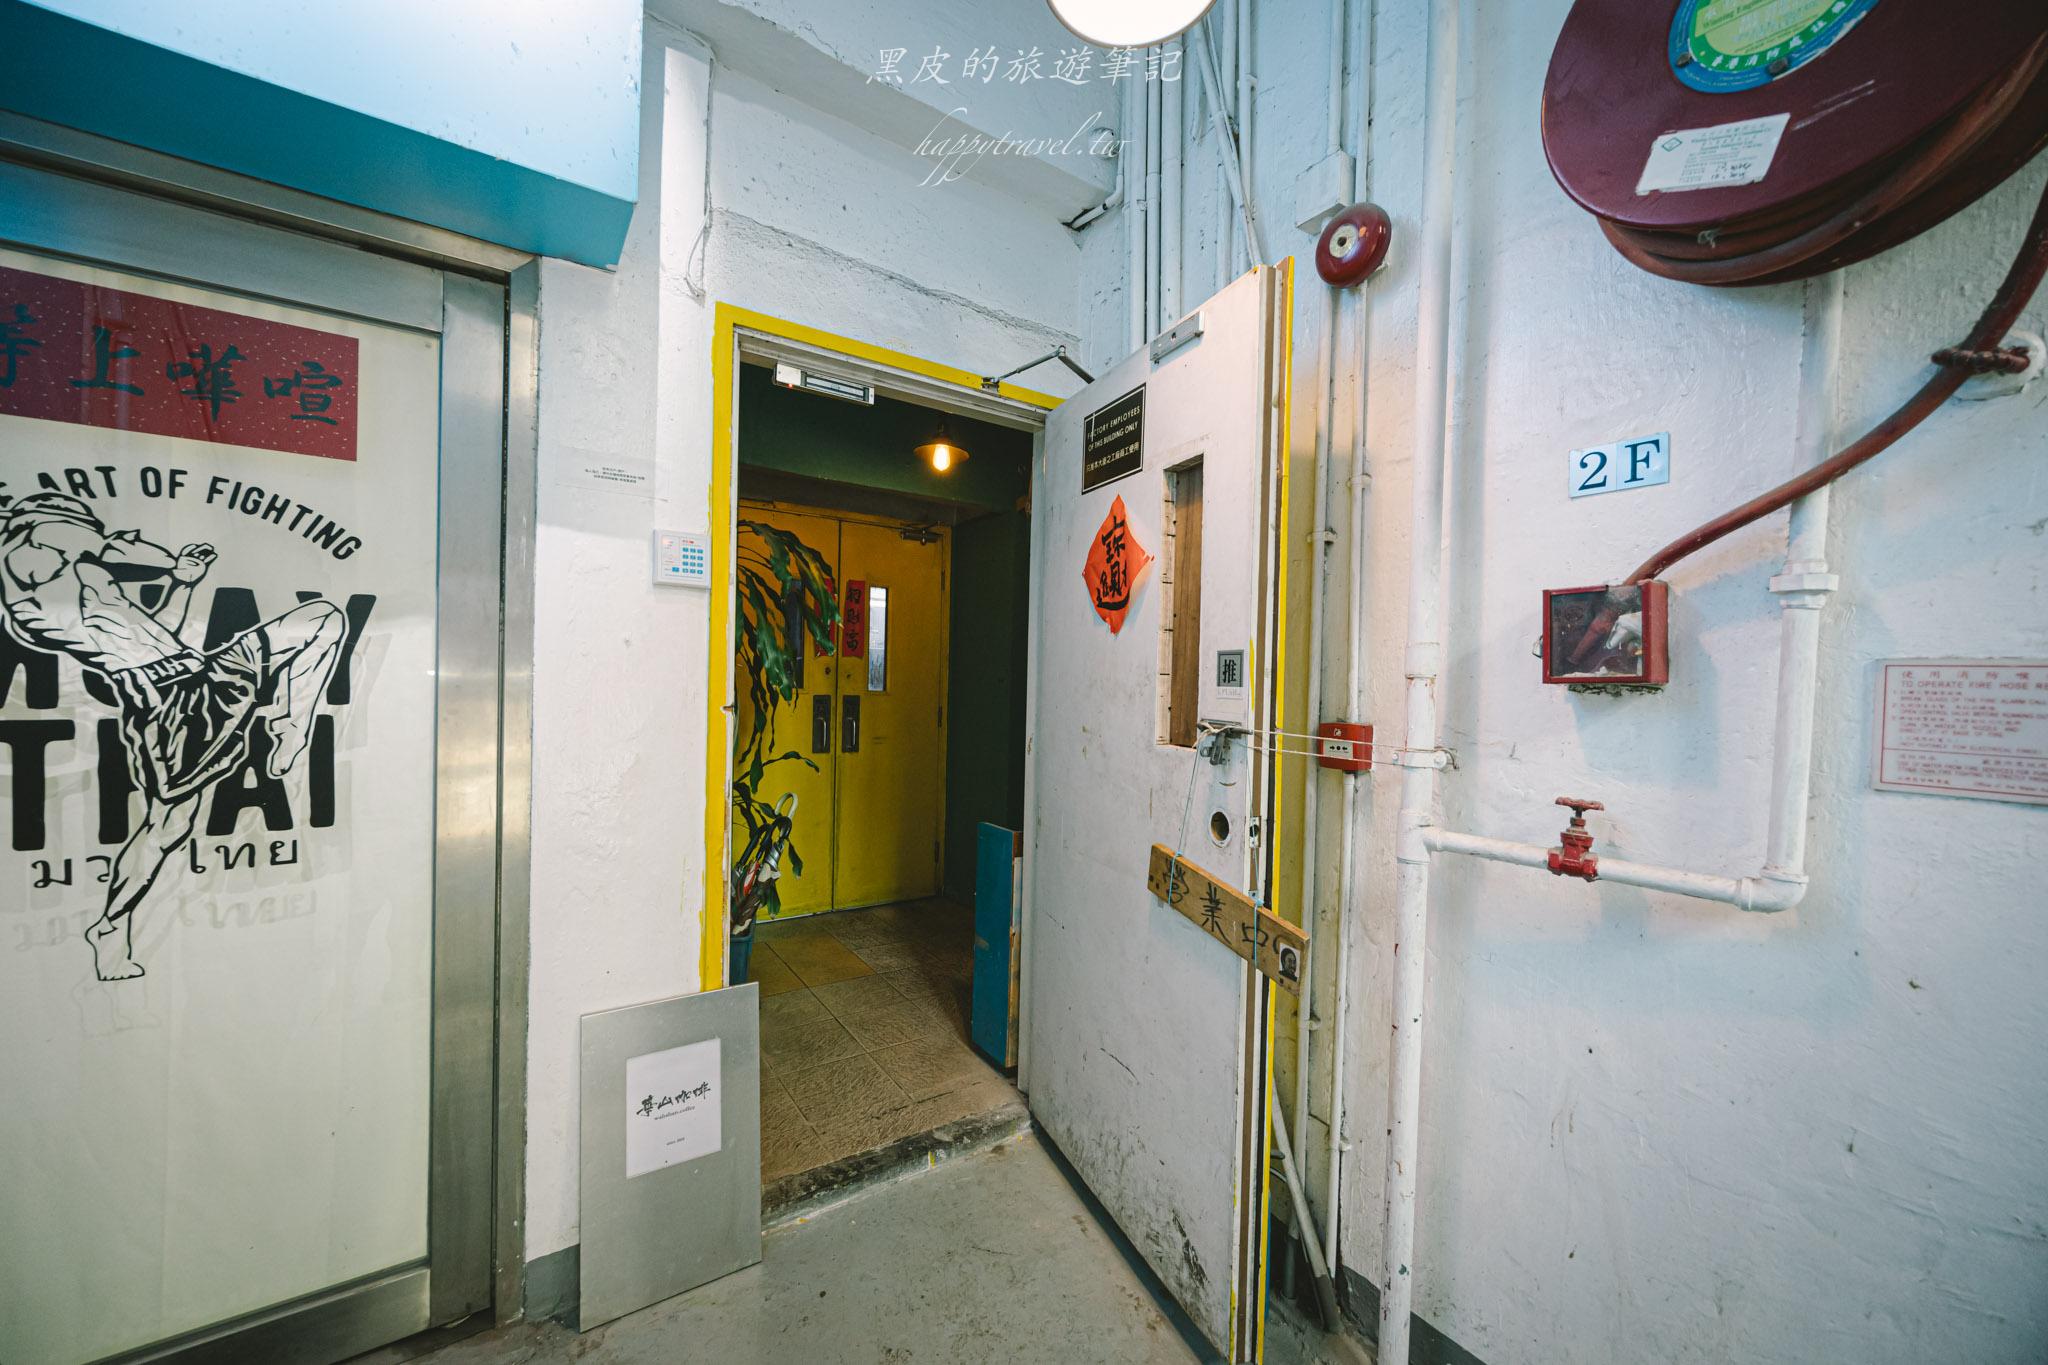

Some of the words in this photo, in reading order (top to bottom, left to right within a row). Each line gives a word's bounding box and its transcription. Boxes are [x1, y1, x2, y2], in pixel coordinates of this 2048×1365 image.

[1110, 406, 1140, 427] EMPLOYEES
[1088, 443, 1094, 452] OF
[1095, 439, 1103, 448] THIS
[1103, 429, 1124, 445] BUILDING
[1125, 421, 1138, 434] ONLY
[140, 466, 188, 499] OF
[206, 476, 363, 560] FIGHTING
[1222, 659, 1237, 684] 推
[1917, 680, 1964, 689] OPERATE
[2000, 681, 2029, 690] HOSE
